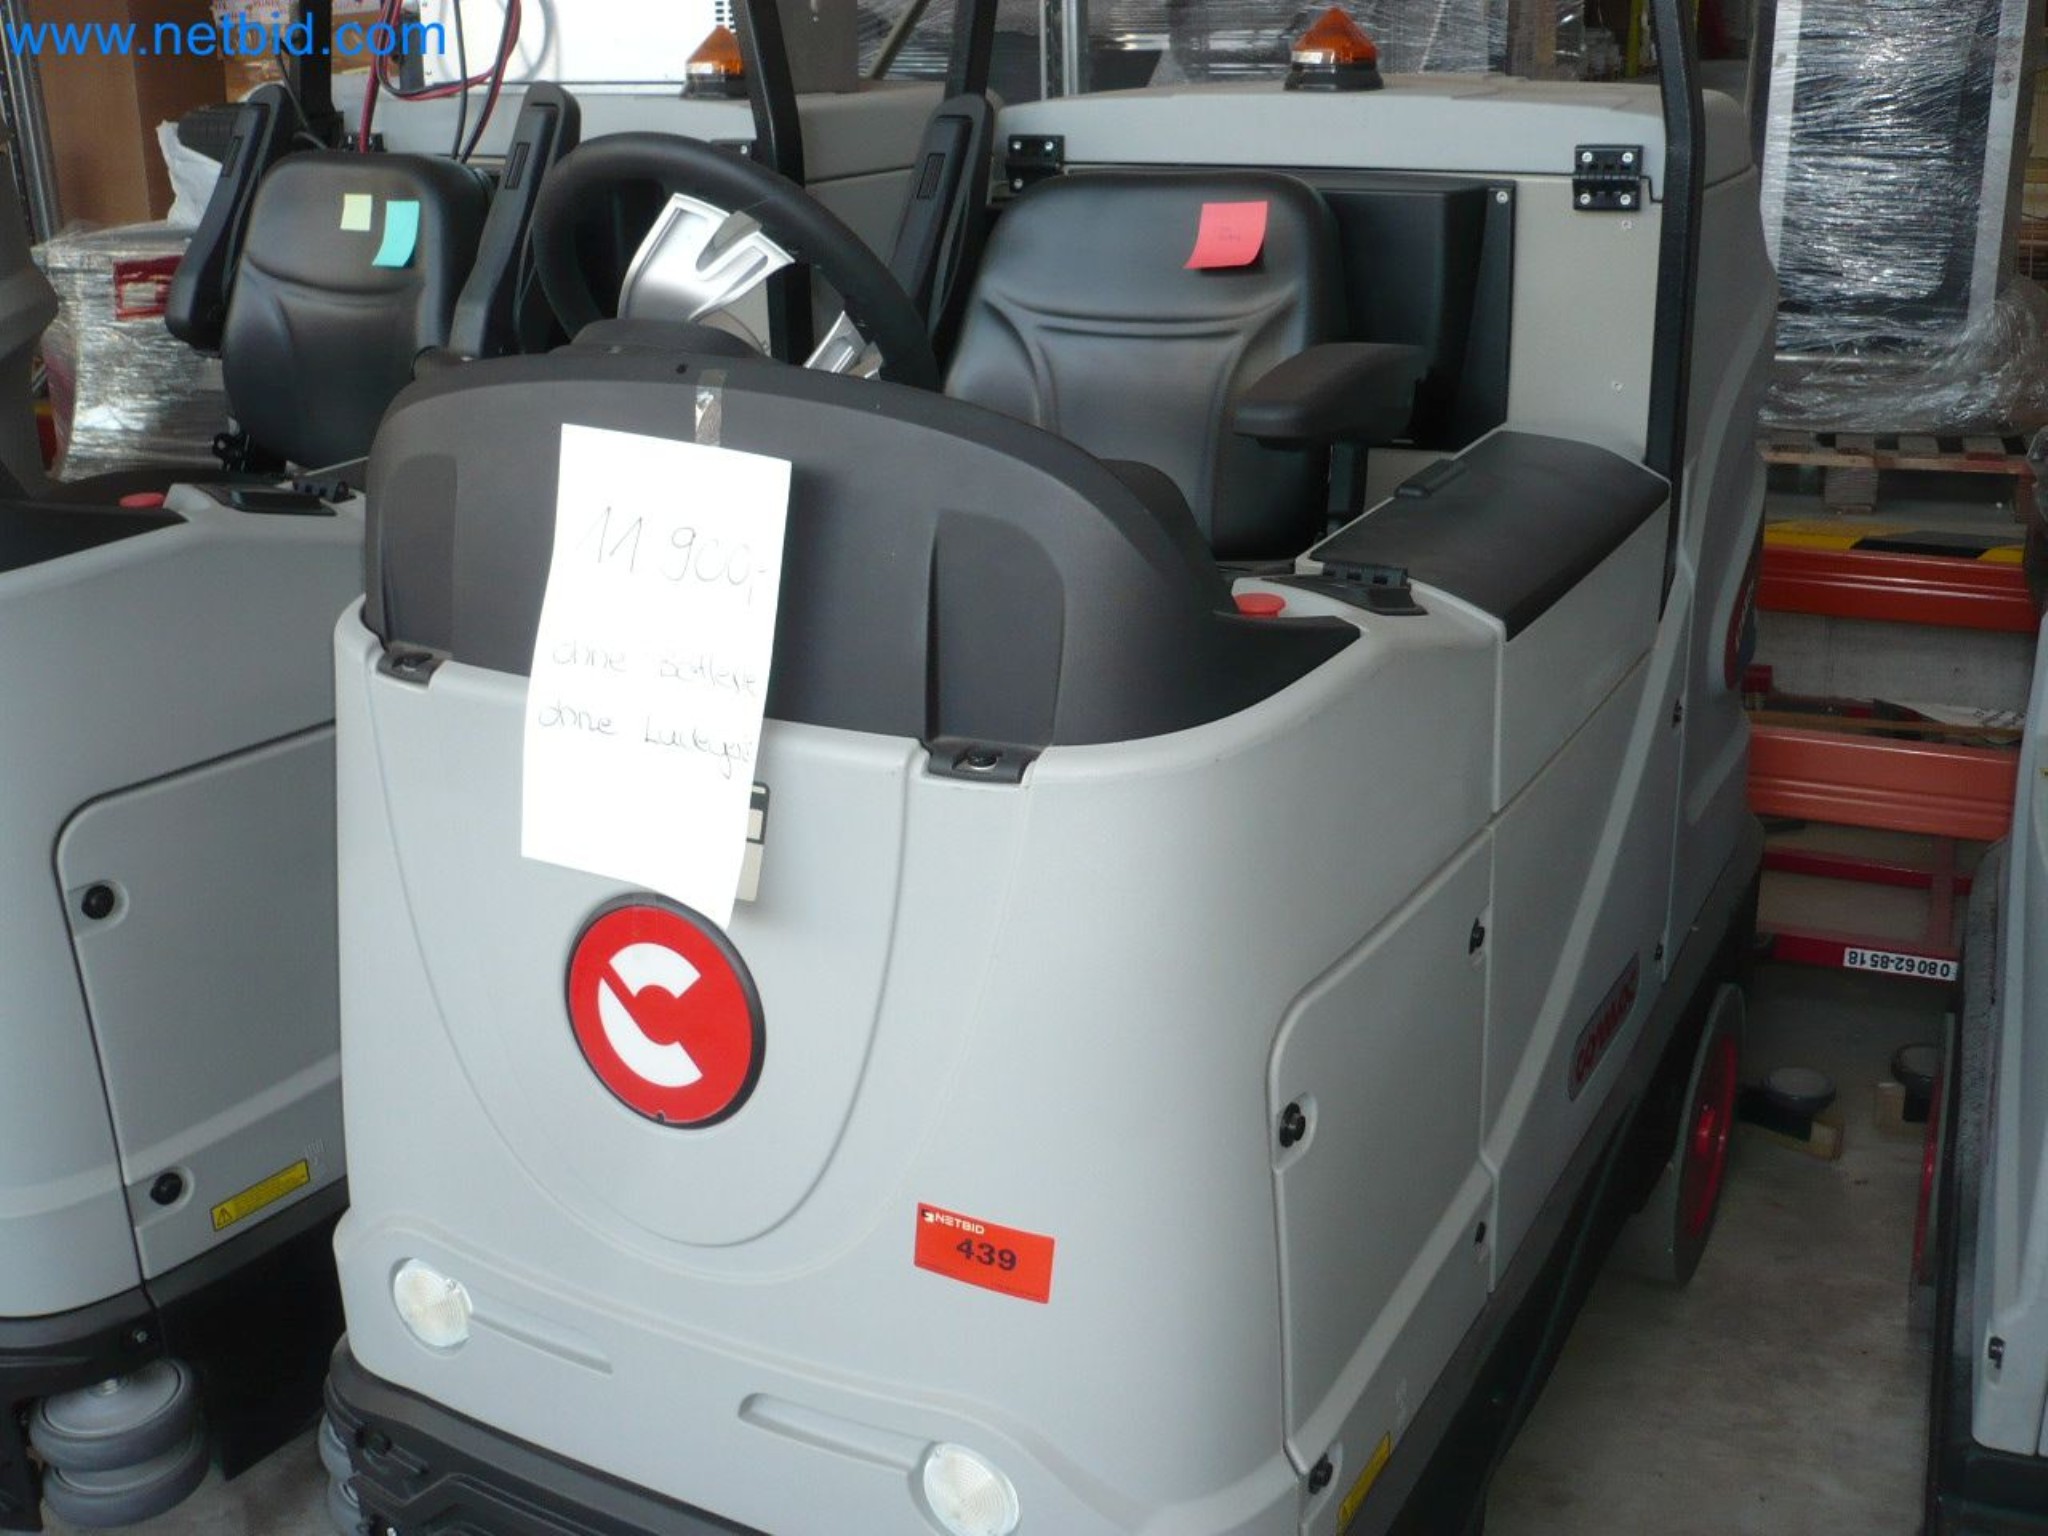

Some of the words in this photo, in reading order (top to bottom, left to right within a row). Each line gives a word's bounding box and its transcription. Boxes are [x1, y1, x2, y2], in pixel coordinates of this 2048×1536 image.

[576, 506, 643, 573] 11
[552, 639, 627, 673] ohne
[538, 697, 619, 735] ohne
[1848, 950, 1951, 978] 08062-8518
[935, 1213, 985, 1235] NETBID
[955, 1238, 1018, 1271] 439
